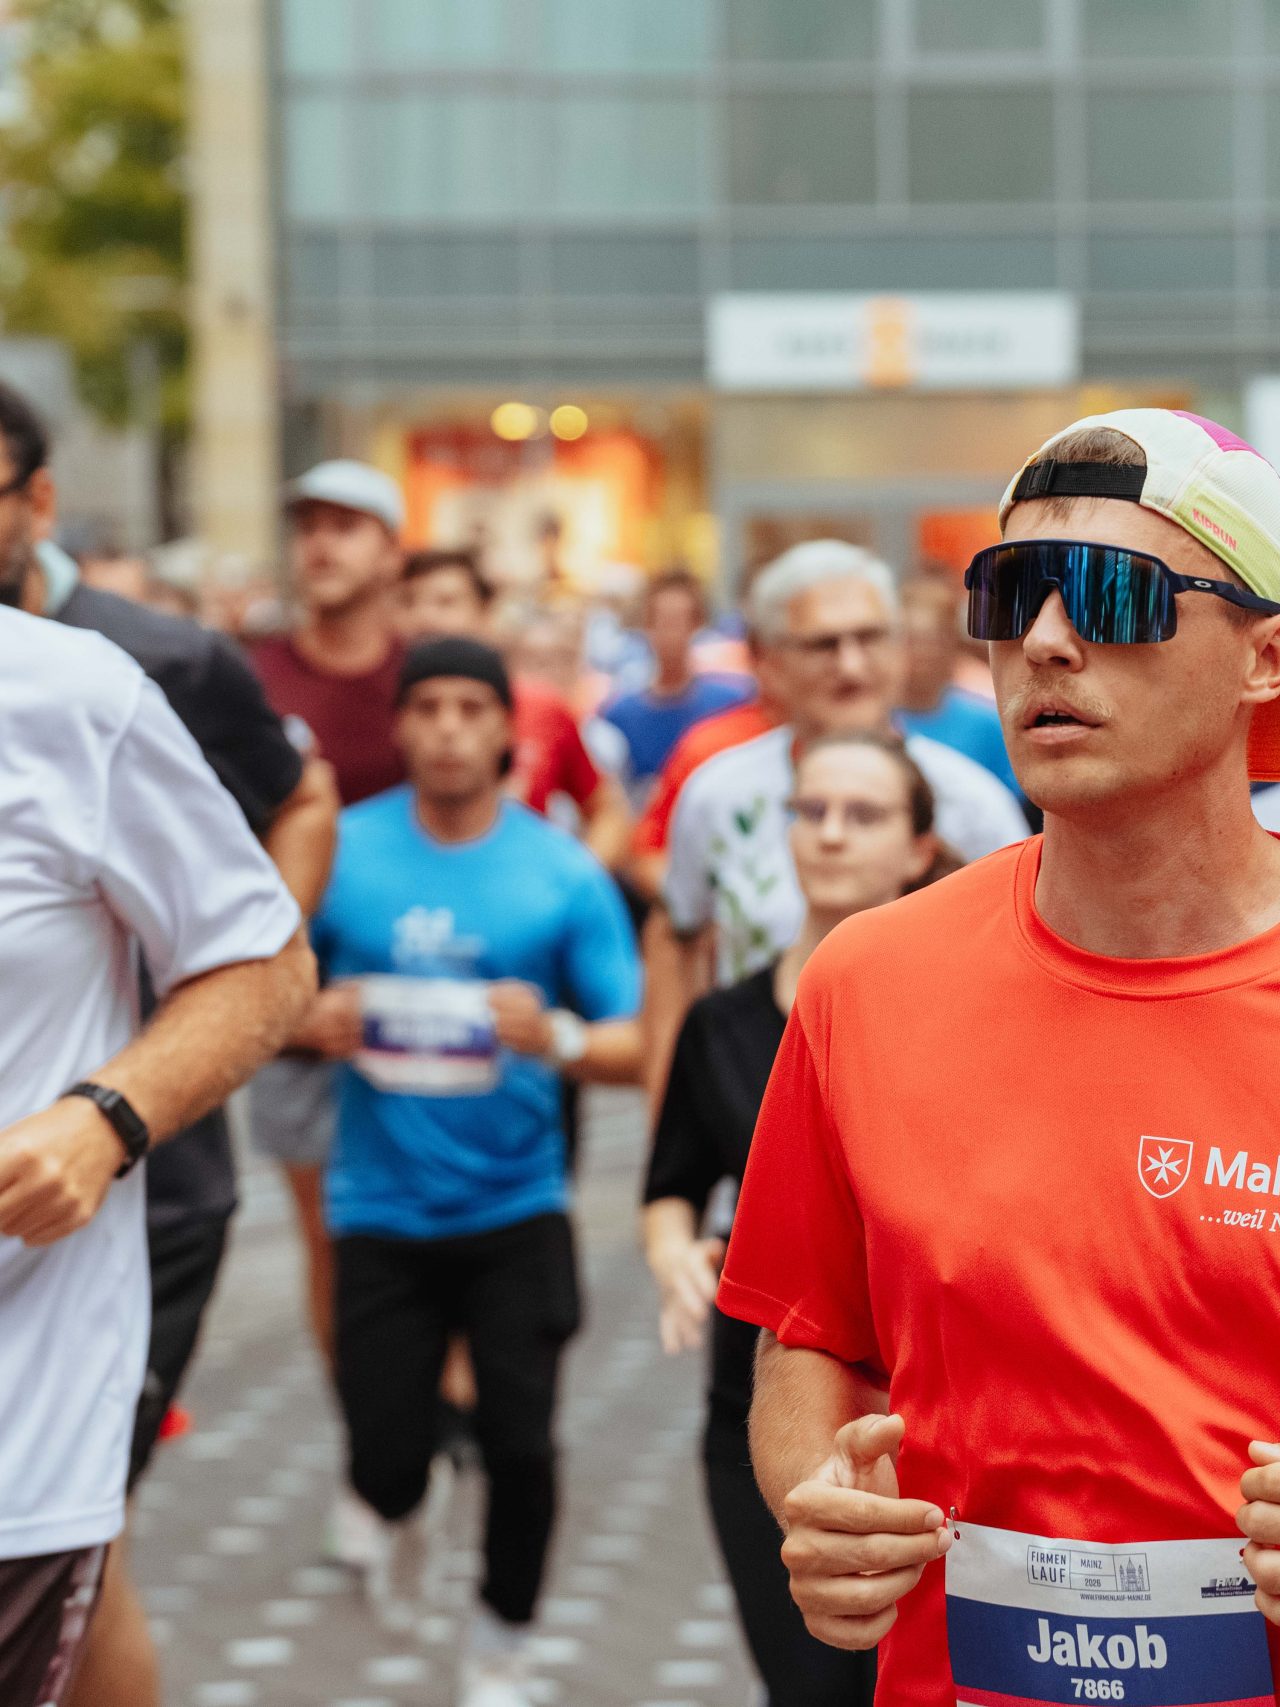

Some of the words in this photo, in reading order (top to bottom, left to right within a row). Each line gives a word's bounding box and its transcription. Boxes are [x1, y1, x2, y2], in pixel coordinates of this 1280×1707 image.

[1192, 508, 1237, 551] KIPRUN
[1031, 1551, 1067, 1565] FIRMEN
[1080, 1558, 1104, 1570] MAINZ
[1031, 1564, 1067, 1583] LAUF
[1026, 1617, 1168, 1670] Jakob
[1070, 1677, 1125, 1700] 7866
